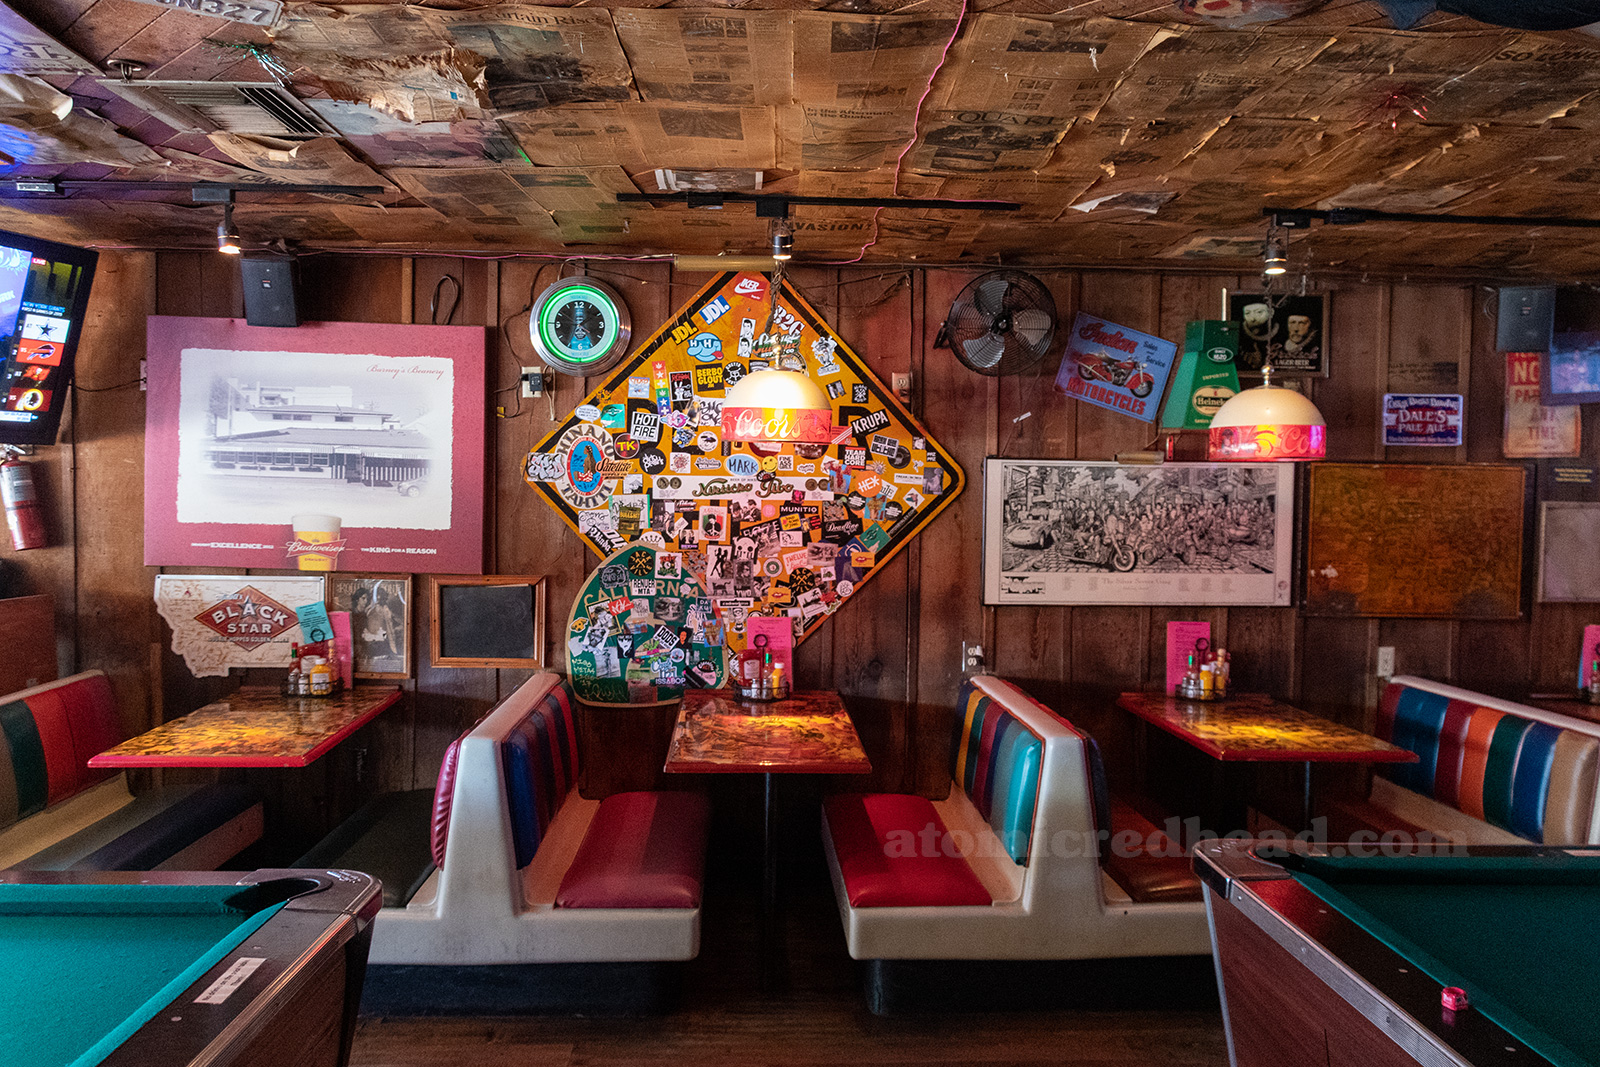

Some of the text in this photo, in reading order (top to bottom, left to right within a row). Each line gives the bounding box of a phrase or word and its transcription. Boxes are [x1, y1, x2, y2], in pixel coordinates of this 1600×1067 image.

[574, 301, 584, 309] 12
[555, 321, 561, 329] 9
[598, 321, 604, 329] 3
[1079, 322, 1138, 354] Indian
[366, 364, 444, 380] Barney's Beanery
[696, 367, 723, 377] BERBO
[697, 375, 723, 385] GLOUT
[1066, 377, 1147, 415] MOTORCYCLES
[635, 414, 657, 426] HOT
[734, 409, 801, 438] Coors
[852, 411, 888, 433] KRUPA
[633, 426, 656, 438] FIRE
[556, 425, 615, 457] HINANO
[617, 440, 636, 451] TK
[728, 459, 758, 473] MARK
[858, 475, 880, 492] HEX
[561, 483, 613, 508] TAHITI
[286, 541, 345, 552] Budweiser
[406, 547, 437, 555] REASON
[630, 551, 653, 561] JACK
[584, 579, 699, 605] CALIRNA
[211, 603, 288, 627] BLACK
[227, 623, 272, 634] STAR
